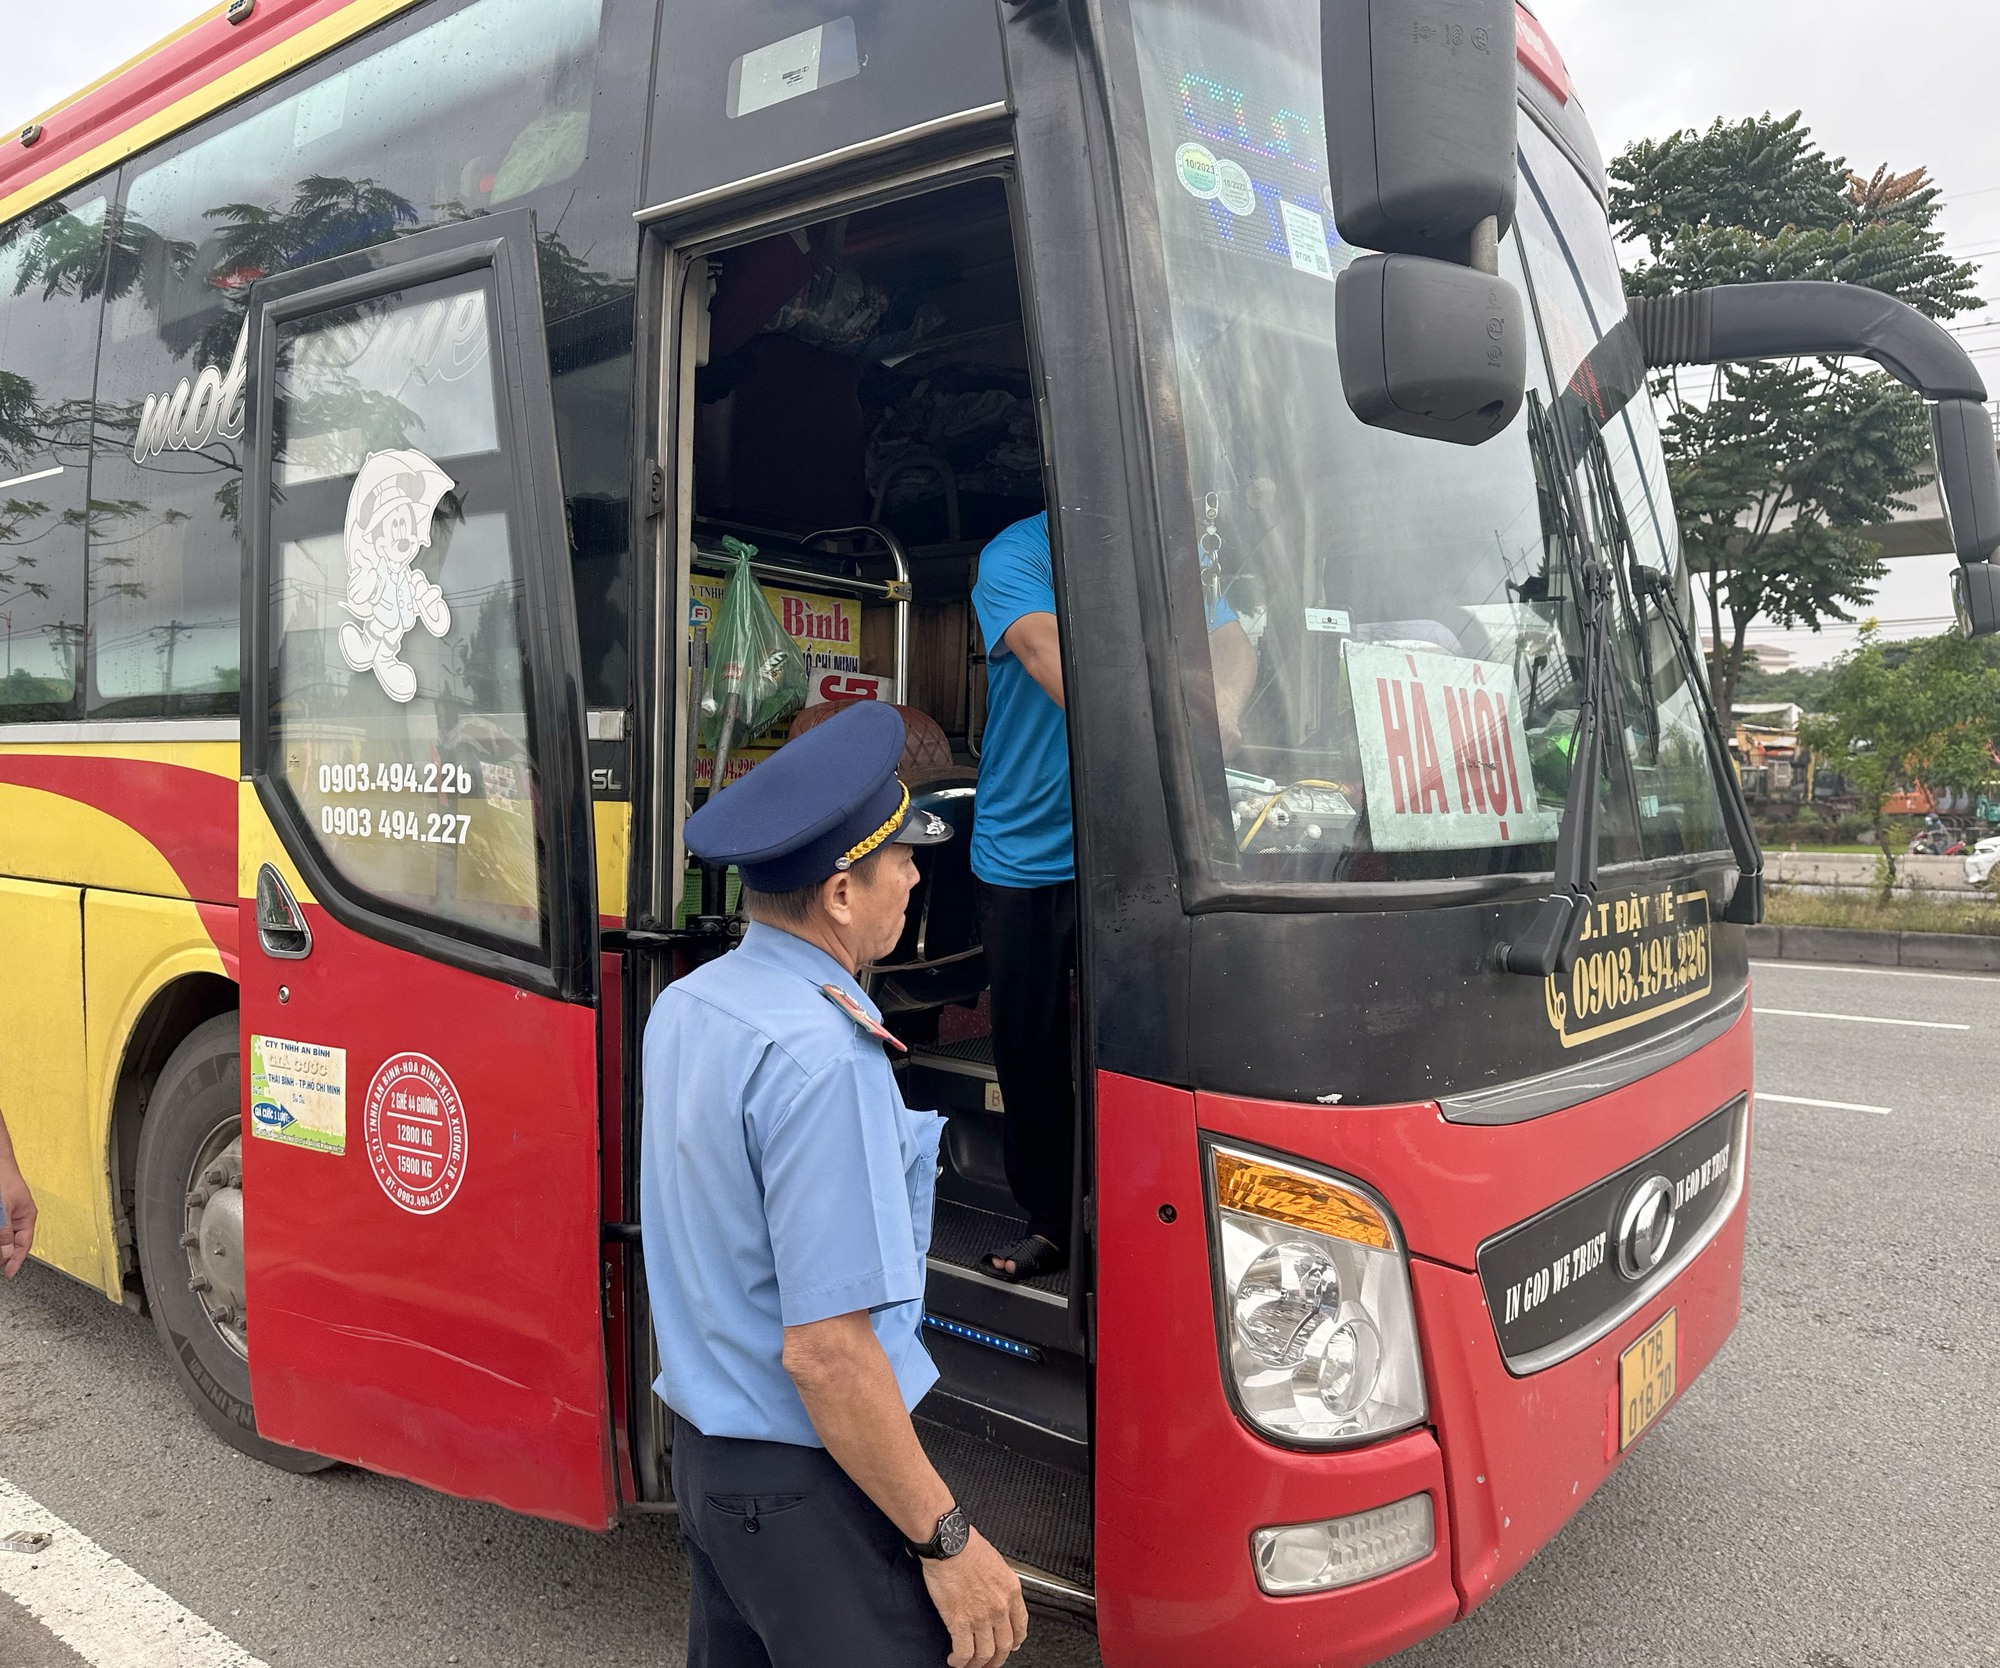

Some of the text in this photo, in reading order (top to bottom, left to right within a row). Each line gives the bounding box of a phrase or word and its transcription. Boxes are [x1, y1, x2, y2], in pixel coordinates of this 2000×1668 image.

[1185, 158, 1215, 175] 10/2023
[699, 585, 724, 600] TNHH
[781, 596, 850, 643] Bình
[1376, 653, 1524, 841] HÀ NỘI
[321, 805, 472, 844] 0903 494.227
[1615, 891, 1650, 938] ĐẶT
[1572, 926, 1707, 1020] 0903.494.226
[265, 1040, 331, 1058] CTY TNHH AN BÌNH
[327, 1086, 341, 1098] MINH
[373, 1083, 385, 1102] AN
[391, 1092, 396, 1108] 2
[369, 1101, 379, 1133] TNHH
[397, 1123, 432, 1146] 12800 KG
[397, 1154, 432, 1178] 15900 KG
[1675, 1143, 1730, 1209] IN GOD WE TRUST
[397, 1187, 444, 1207] 0903.494.227
[1505, 1231, 1607, 1324] IN GOD WE TRUST
[1641, 1328, 1663, 1380] 17B
[1629, 1361, 1671, 1437] 018.70
